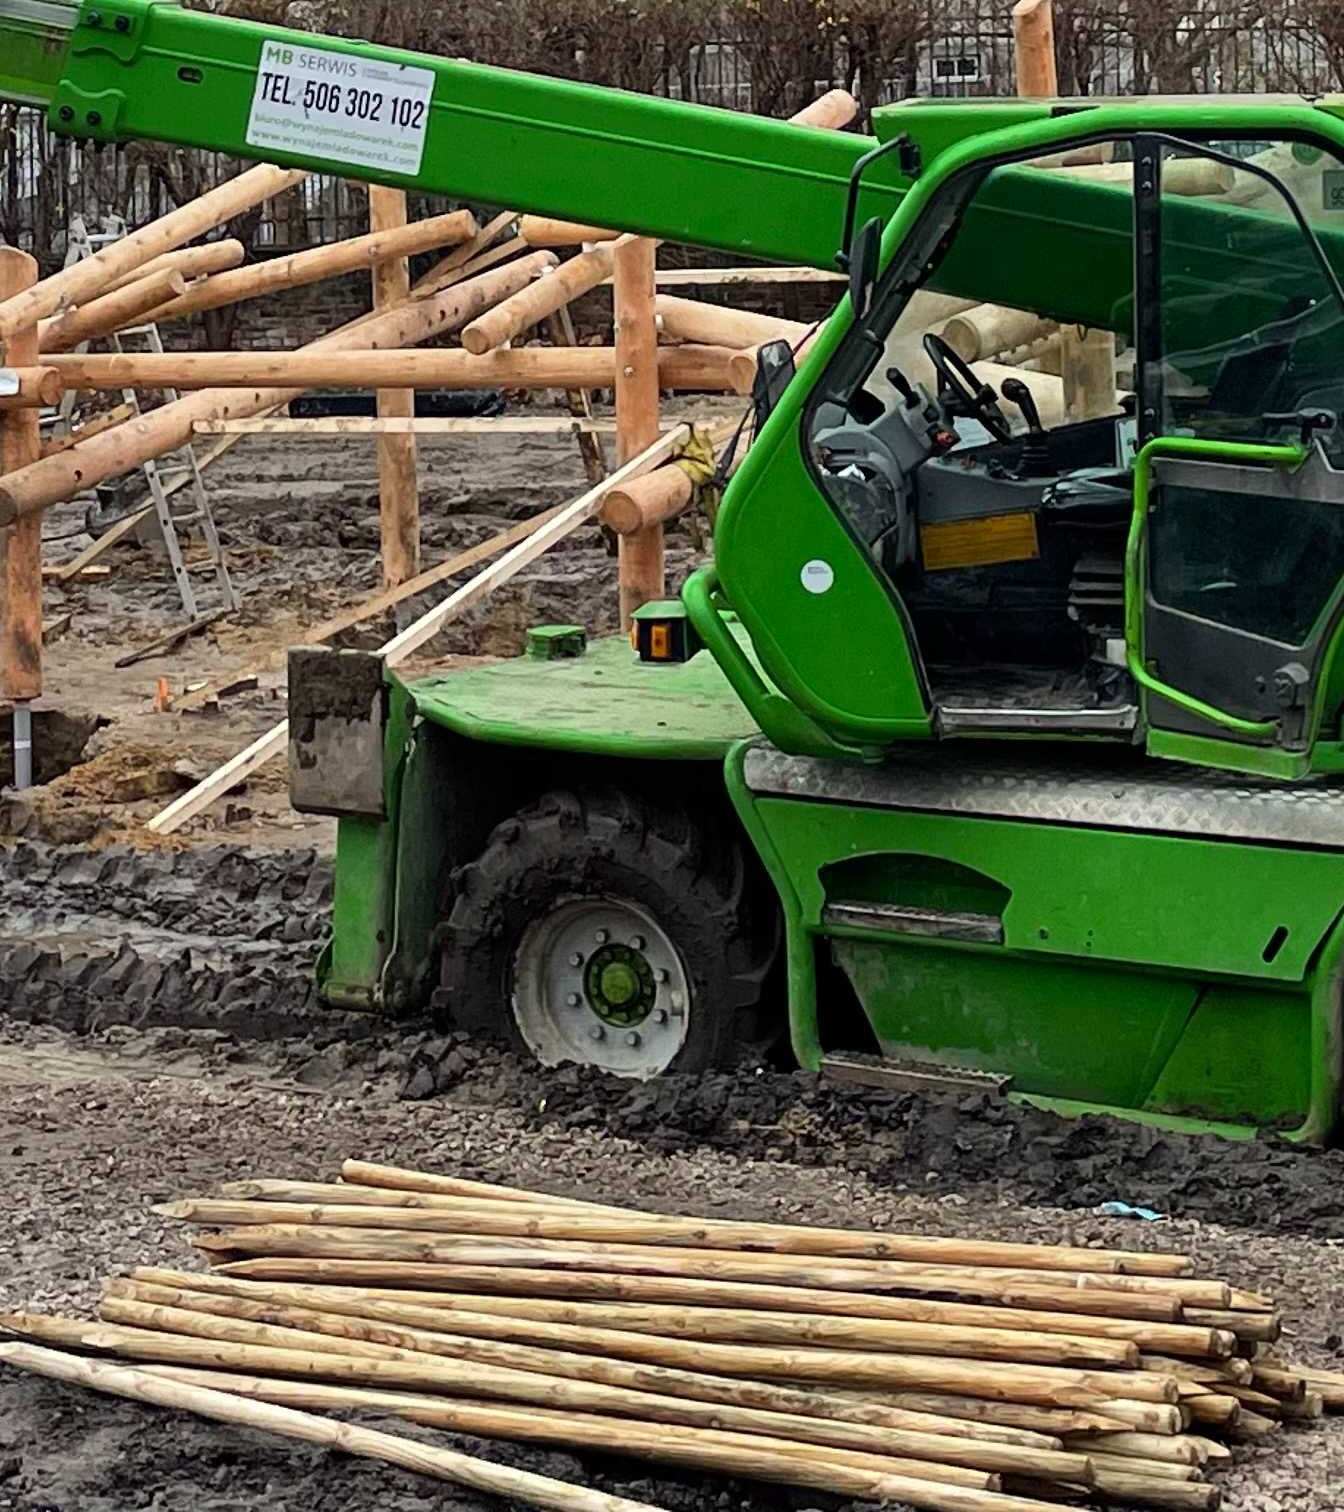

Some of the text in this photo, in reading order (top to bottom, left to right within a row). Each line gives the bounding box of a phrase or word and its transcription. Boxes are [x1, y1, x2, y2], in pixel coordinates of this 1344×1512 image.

[266, 47, 357, 77] MB SERWIS
[261, 72, 425, 129] TEL. 506 302 102
